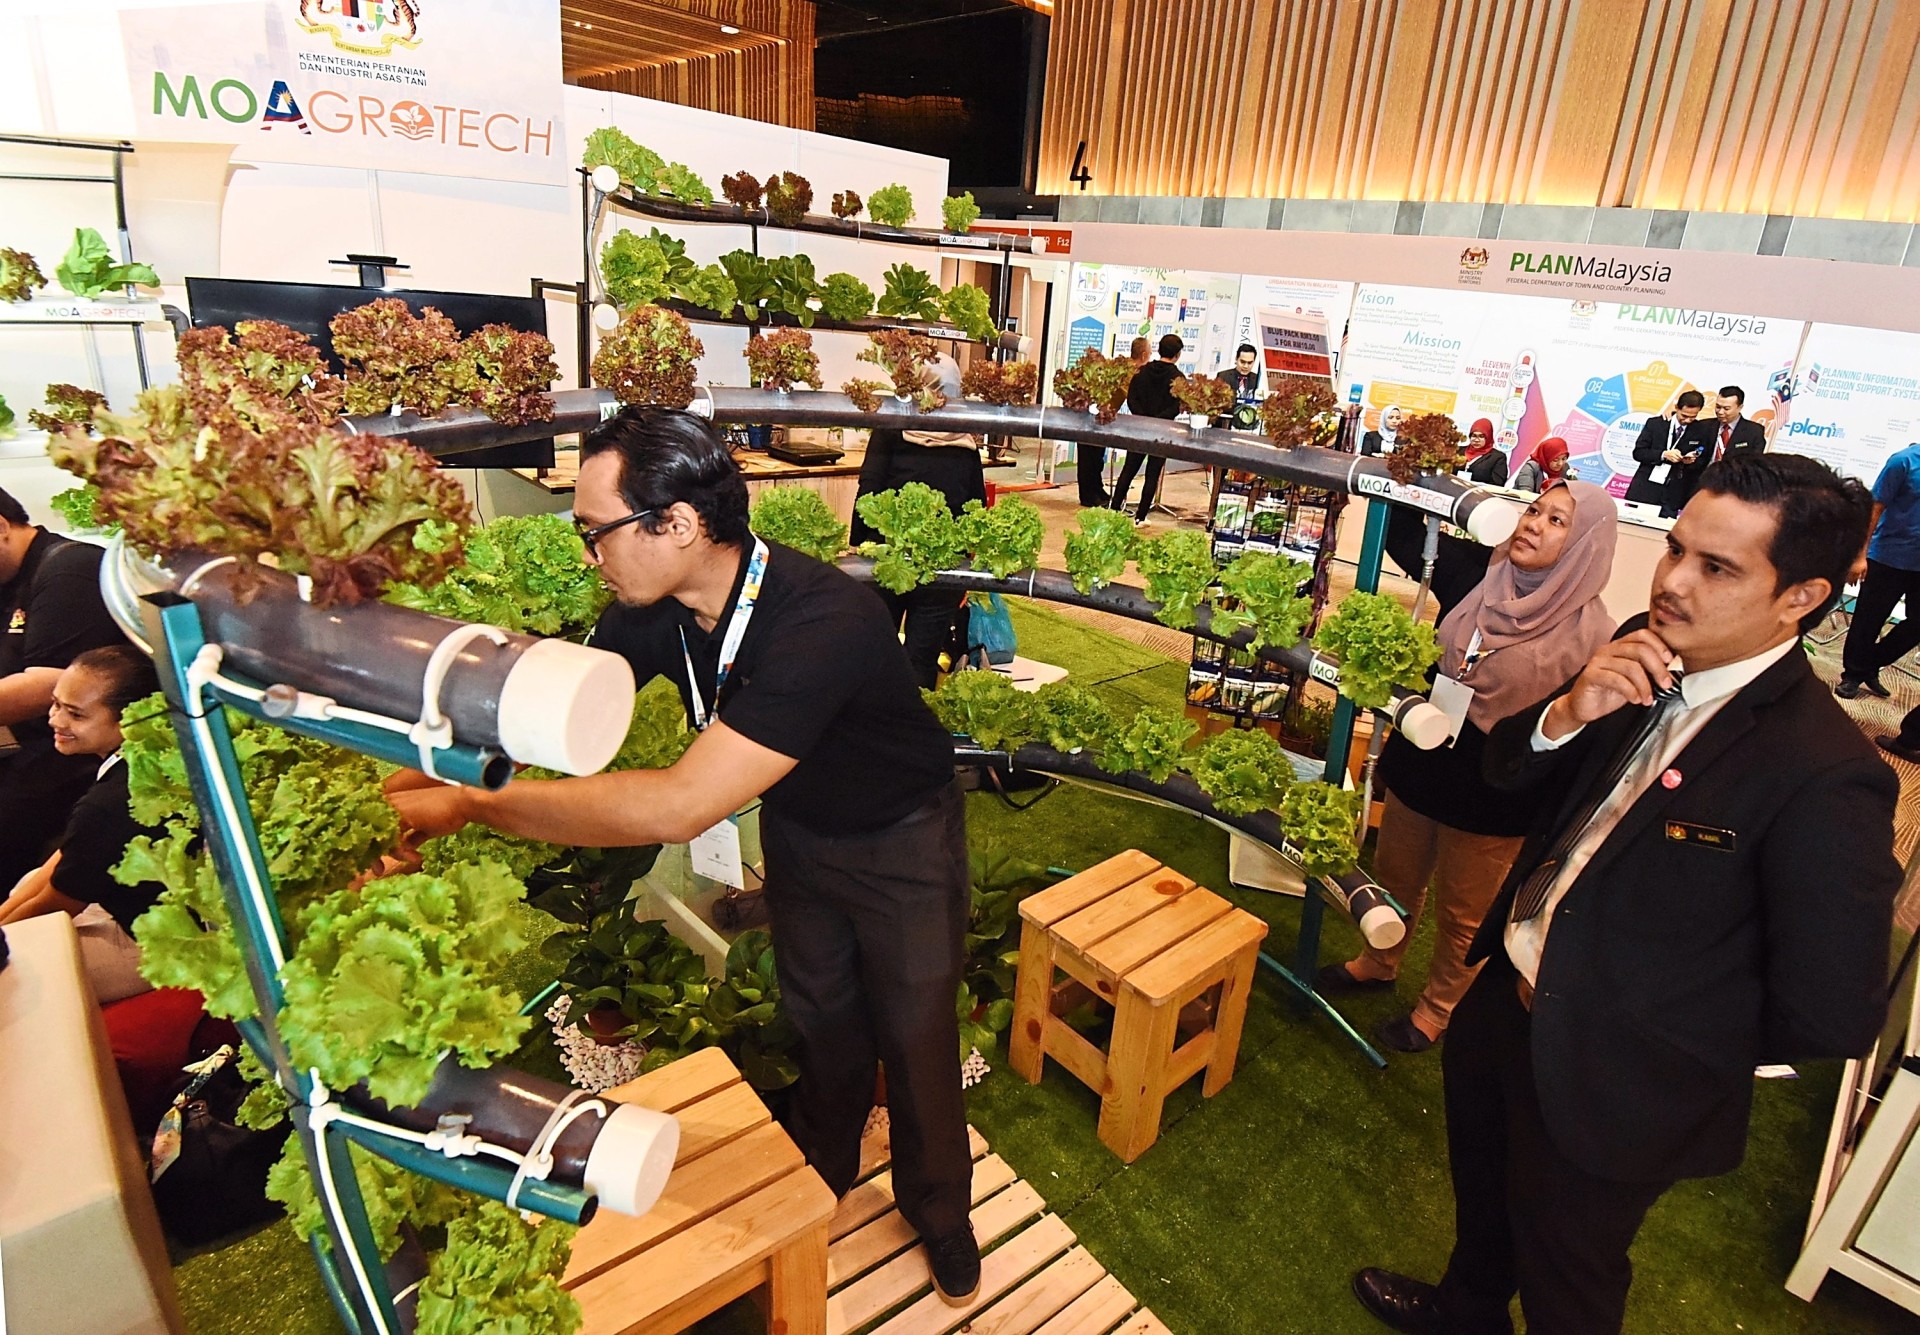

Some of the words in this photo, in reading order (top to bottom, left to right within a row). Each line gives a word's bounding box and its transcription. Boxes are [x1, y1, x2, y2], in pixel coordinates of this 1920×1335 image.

[299, 53, 370, 69] KEMENTERIAN
[373, 62, 426, 77] PERTANIAN
[300, 62, 322, 73] DAN
[325, 66, 373, 79] INDUSTRI
[375, 73, 402, 84] ASAS
[405, 77, 427, 87] TANI
[153, 71, 553, 157] MOAGROTECH
[1070, 141, 1093, 191] 4
[1057, 236, 1070, 247] F12
[1121, 281, 1129, 292] 24
[1129, 281, 1144, 294] SEPT
[1531, 279, 1566, 287] DEPARTMENT
[1605, 285, 1633, 293] COUNTRY
[1127, 323, 1138, 335] OCT
[1267, 327, 1283, 336] BLUE
[1284, 329, 1299, 338] PACK
[1280, 339, 1292, 348] FOR
[1403, 329, 1462, 351] Mission
[1482, 360, 1512, 370] ELEVENTH
[1267, 371, 1286, 380] LITTLE
[1465, 366, 1493, 375] MALAYSIA
[1493, 371, 1510, 379] PLAN
[1822, 367, 1862, 381] PLANNING
[1862, 372, 1918, 389] INFORMATION
[1474, 377, 1507, 388] 2016-2020
[1587, 380, 1604, 394] 08
[1818, 378, 1856, 391] DECISION
[1856, 382, 1892, 396] SUPPORT
[1815, 388, 1829, 398] BIG
[1829, 390, 1850, 401] DATA
[1583, 458, 1599, 467] NUP
